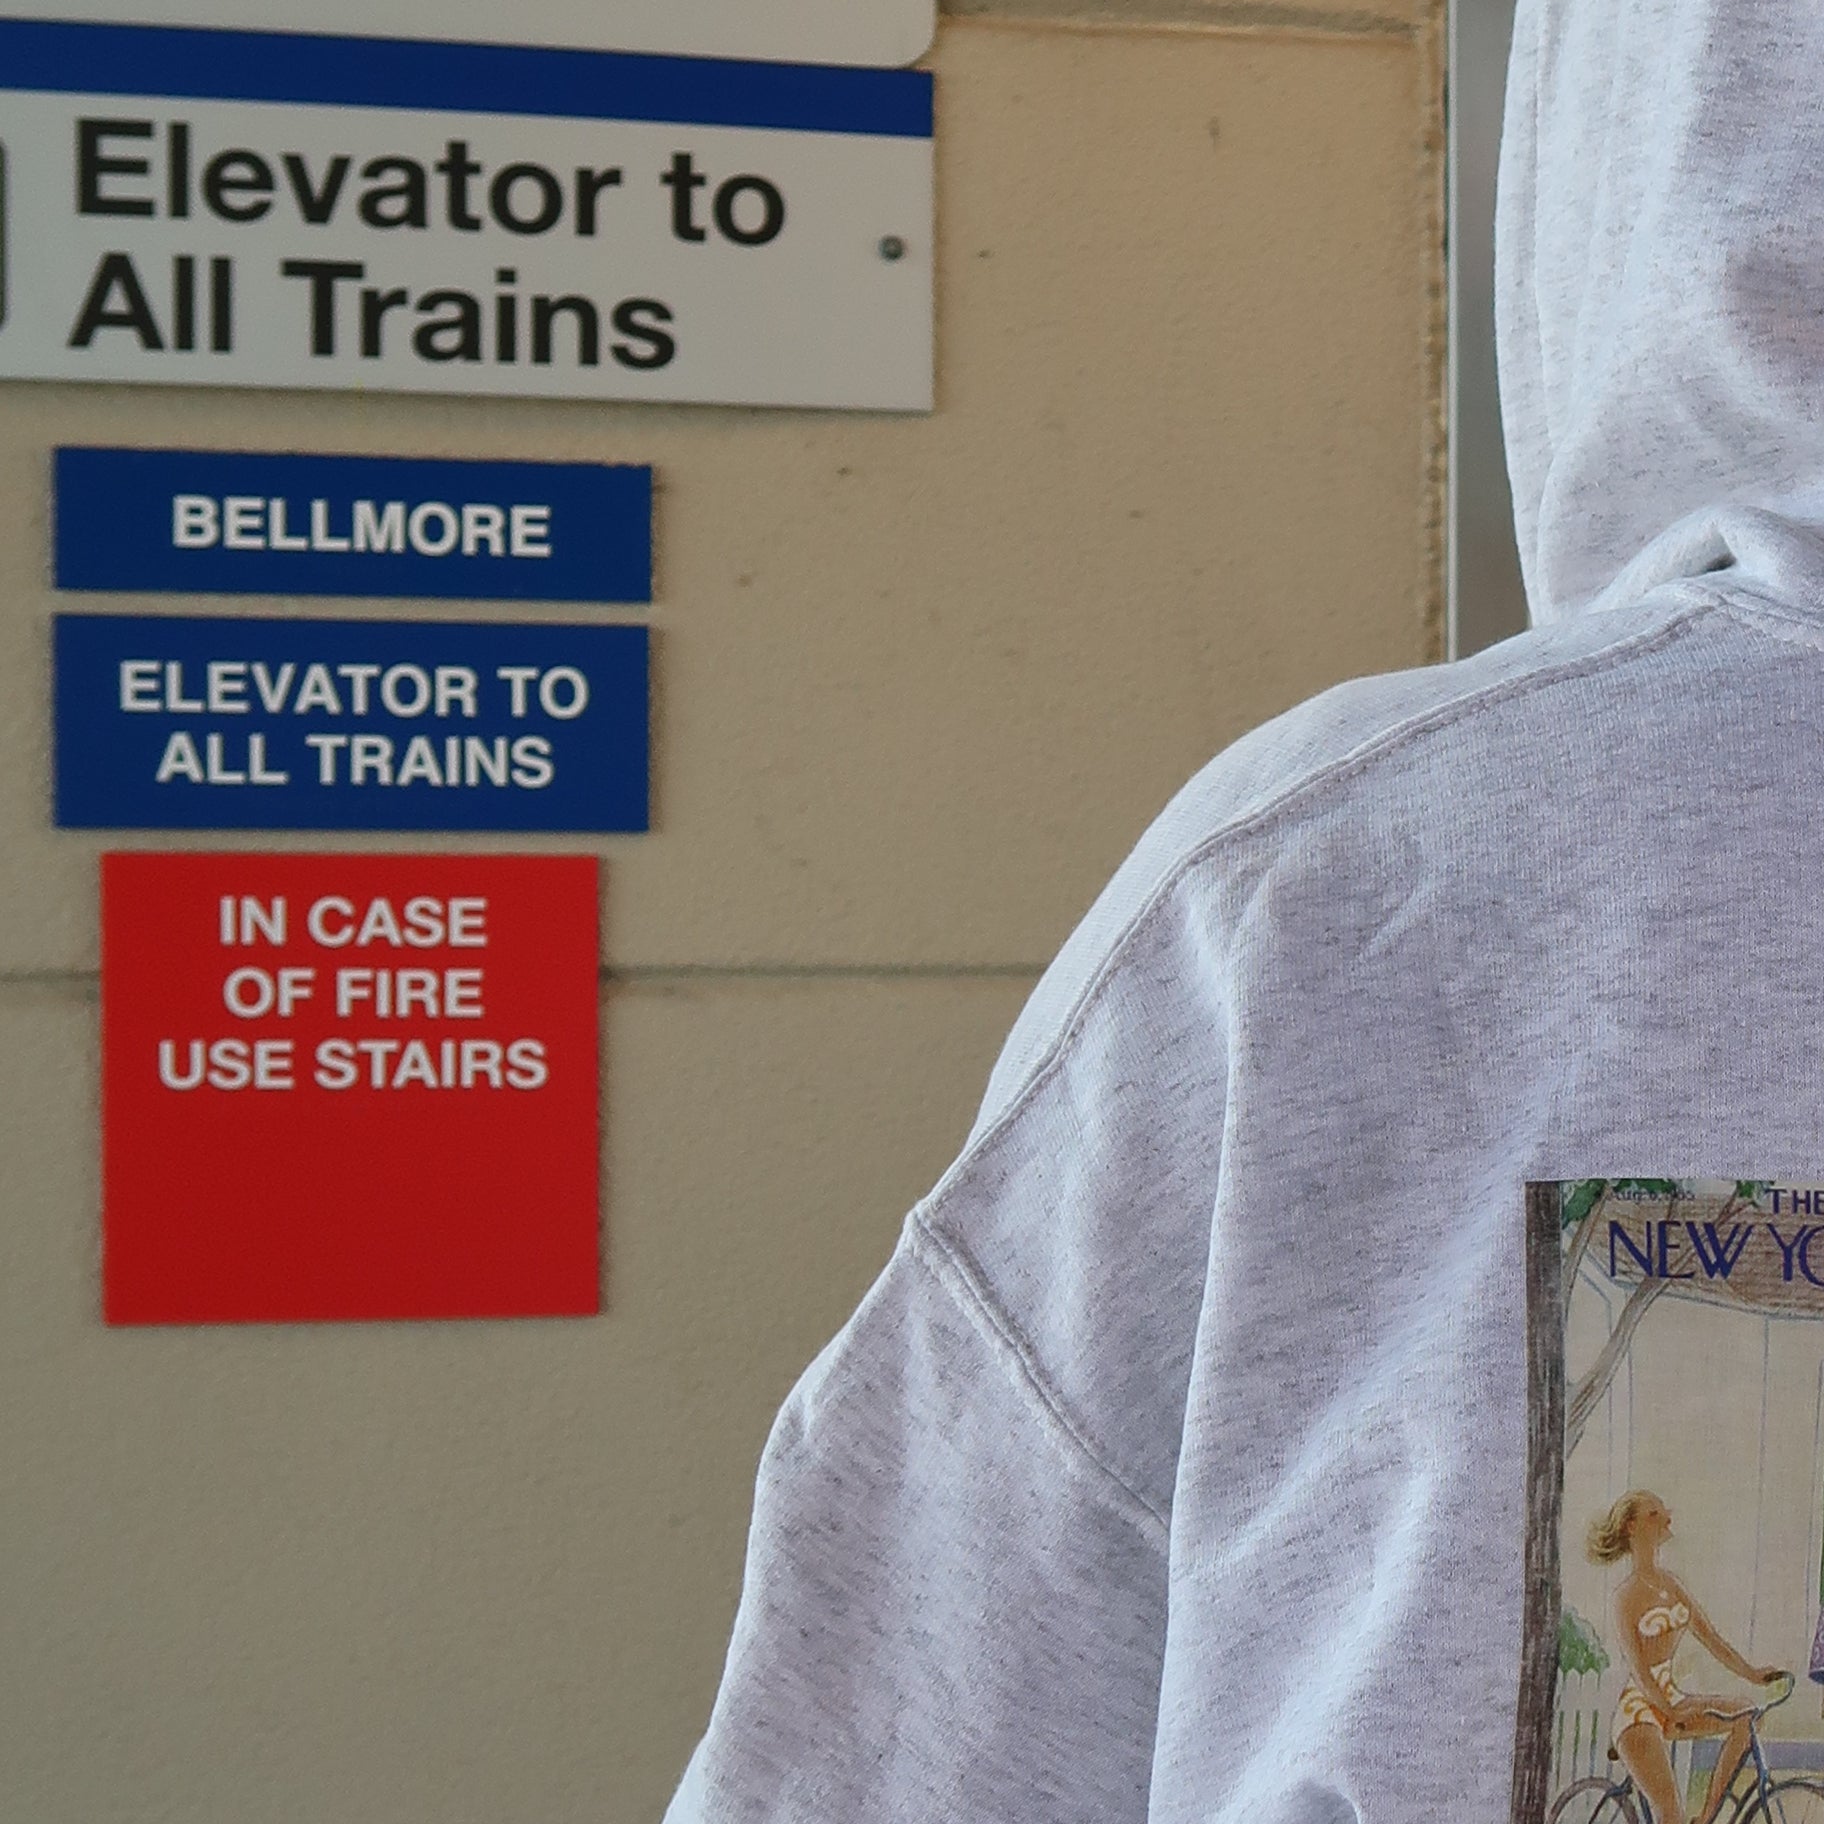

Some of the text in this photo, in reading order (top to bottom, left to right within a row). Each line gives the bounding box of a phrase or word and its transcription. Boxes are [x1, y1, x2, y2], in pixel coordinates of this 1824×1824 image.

[75, 117, 784, 247] Elevator to
[68, 251, 677, 370] All Trains
[172, 494, 552, 557] BELLMORE
[119, 659, 589, 720] ELEVATOR TO
[156, 732, 554, 789] ALL TRAINS
[219, 896, 488, 947] IN CASE
[223, 967, 484, 1018] OF FIRE
[158, 1039, 548, 1091] USE STAIRS
[1608, 1220, 1753, 1280] NEW
